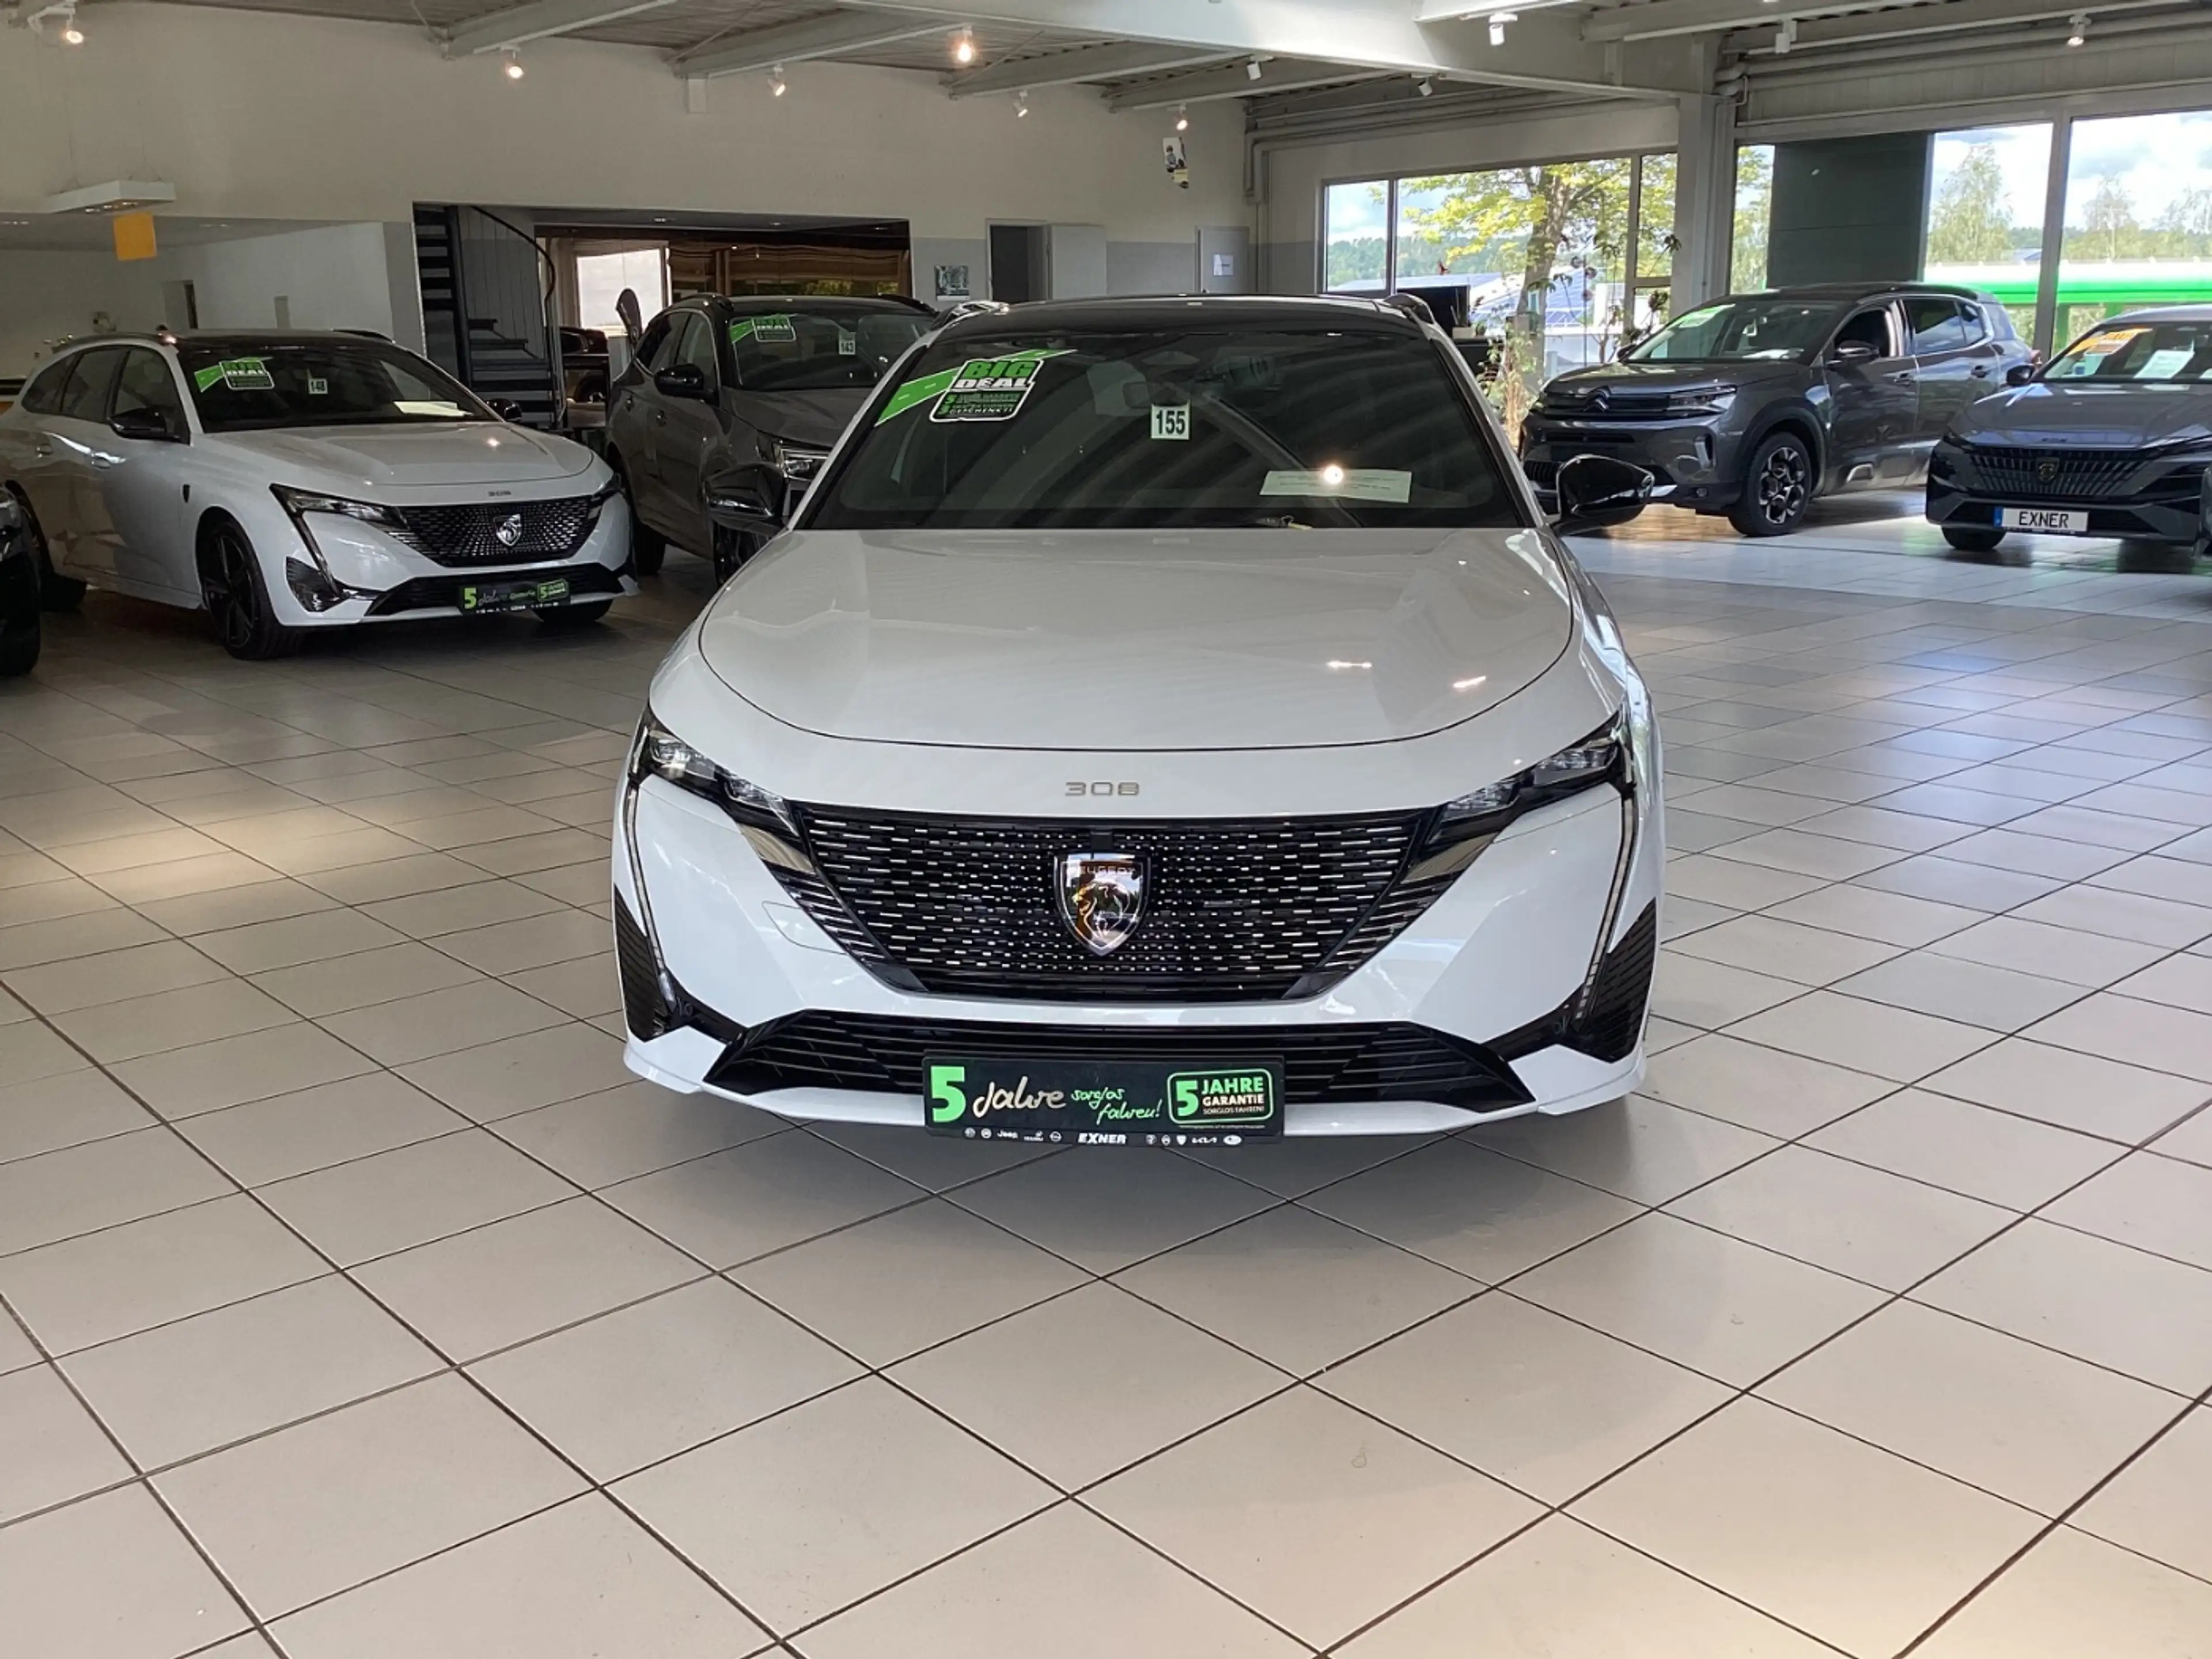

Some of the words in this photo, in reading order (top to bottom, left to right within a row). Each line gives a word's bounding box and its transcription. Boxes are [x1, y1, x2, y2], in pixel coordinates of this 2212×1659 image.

[961, 361, 1036, 378] BIG
[953, 377, 1028, 389] DEAL
[1156, 410, 1186, 435] 155
[2018, 510, 2070, 528] EXNER
[1065, 782, 1140, 796] 308
[930, 1066, 967, 1123] 5
[972, 1075, 1067, 1118] Jahre
[1071, 1086, 1126, 1109] sorglos
[1176, 1080, 1199, 1116] 5
[1201, 1077, 1264, 1095] JAHRE
[1202, 1093, 1265, 1107] GARANTIE
[1096, 1098, 1163, 1126] fahren!
[1078, 1132, 1127, 1145] EXNER
